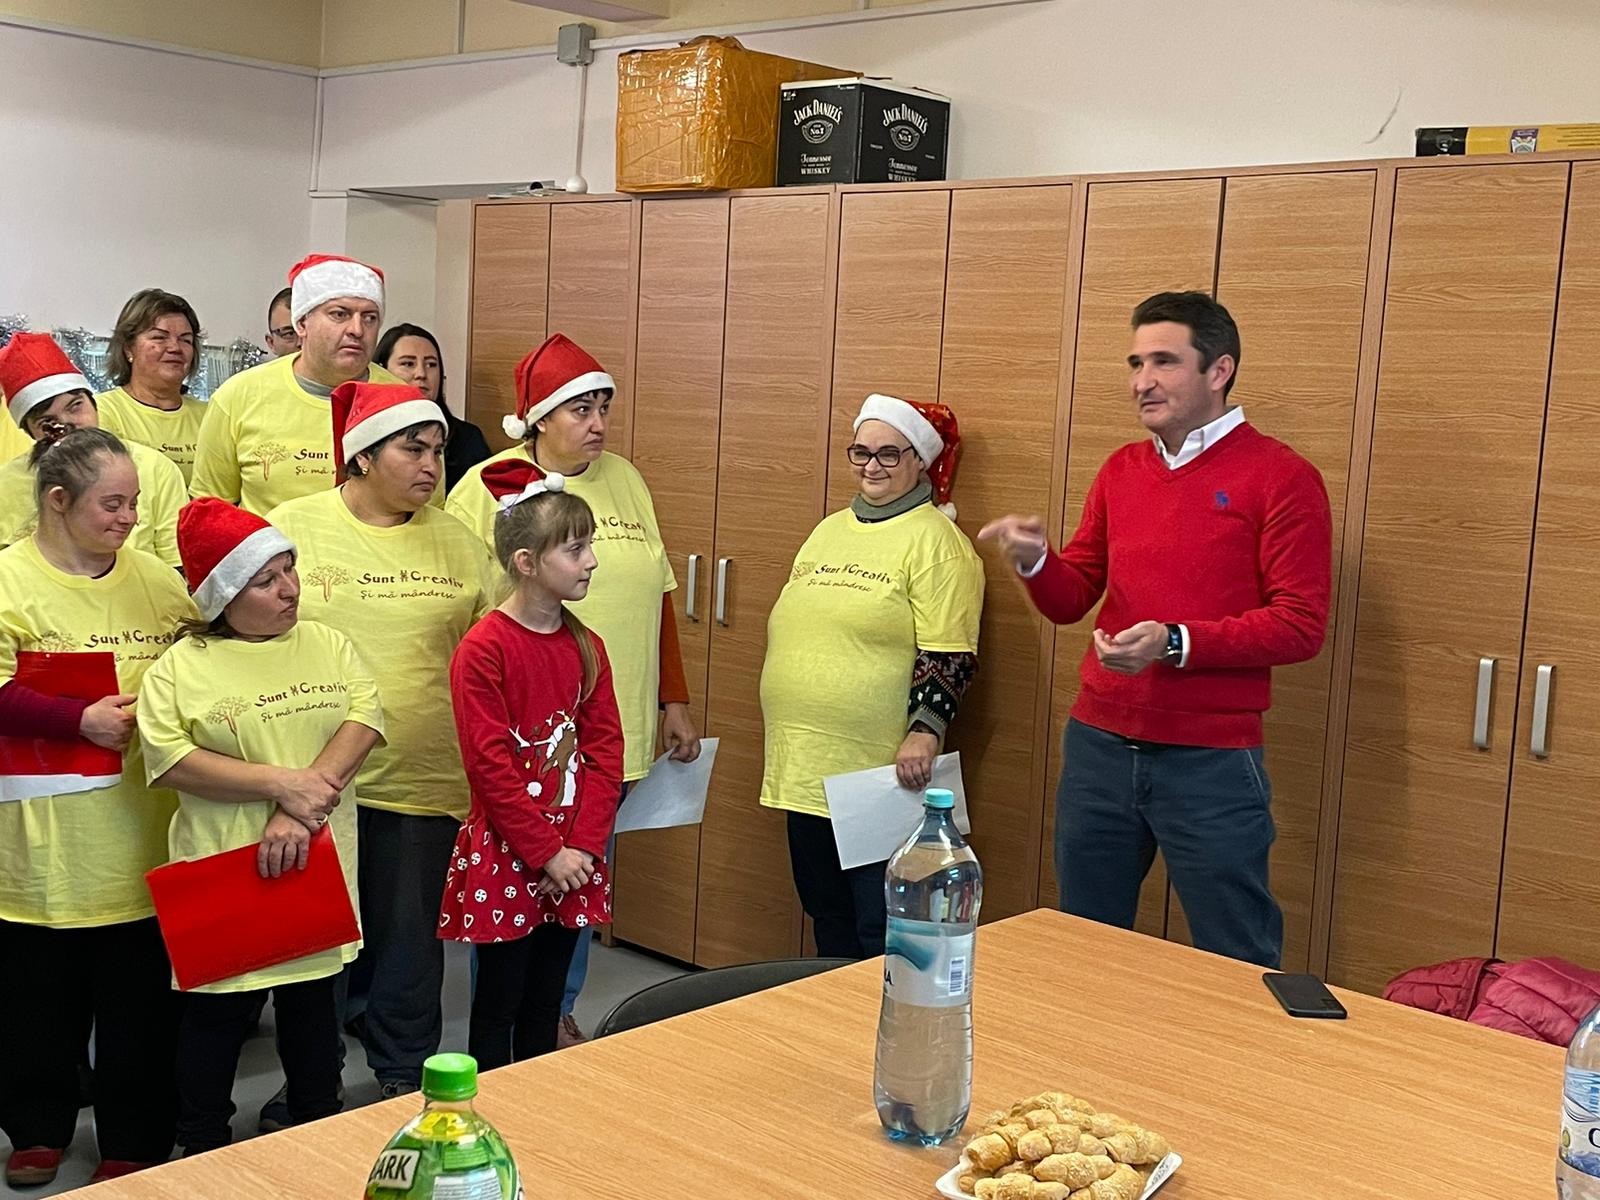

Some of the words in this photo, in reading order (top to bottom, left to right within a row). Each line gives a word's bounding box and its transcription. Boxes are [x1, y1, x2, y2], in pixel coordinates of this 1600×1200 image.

[794, 104, 813, 126] JACK
[883, 106, 900, 127] JACK
[801, 167, 831, 175] WHISKEY
[293, 448, 328, 460] Sunt
[815, 564, 840, 574] Sunt
[357, 573, 395, 585] Sunt
[254, 692, 288, 707] Sunt
